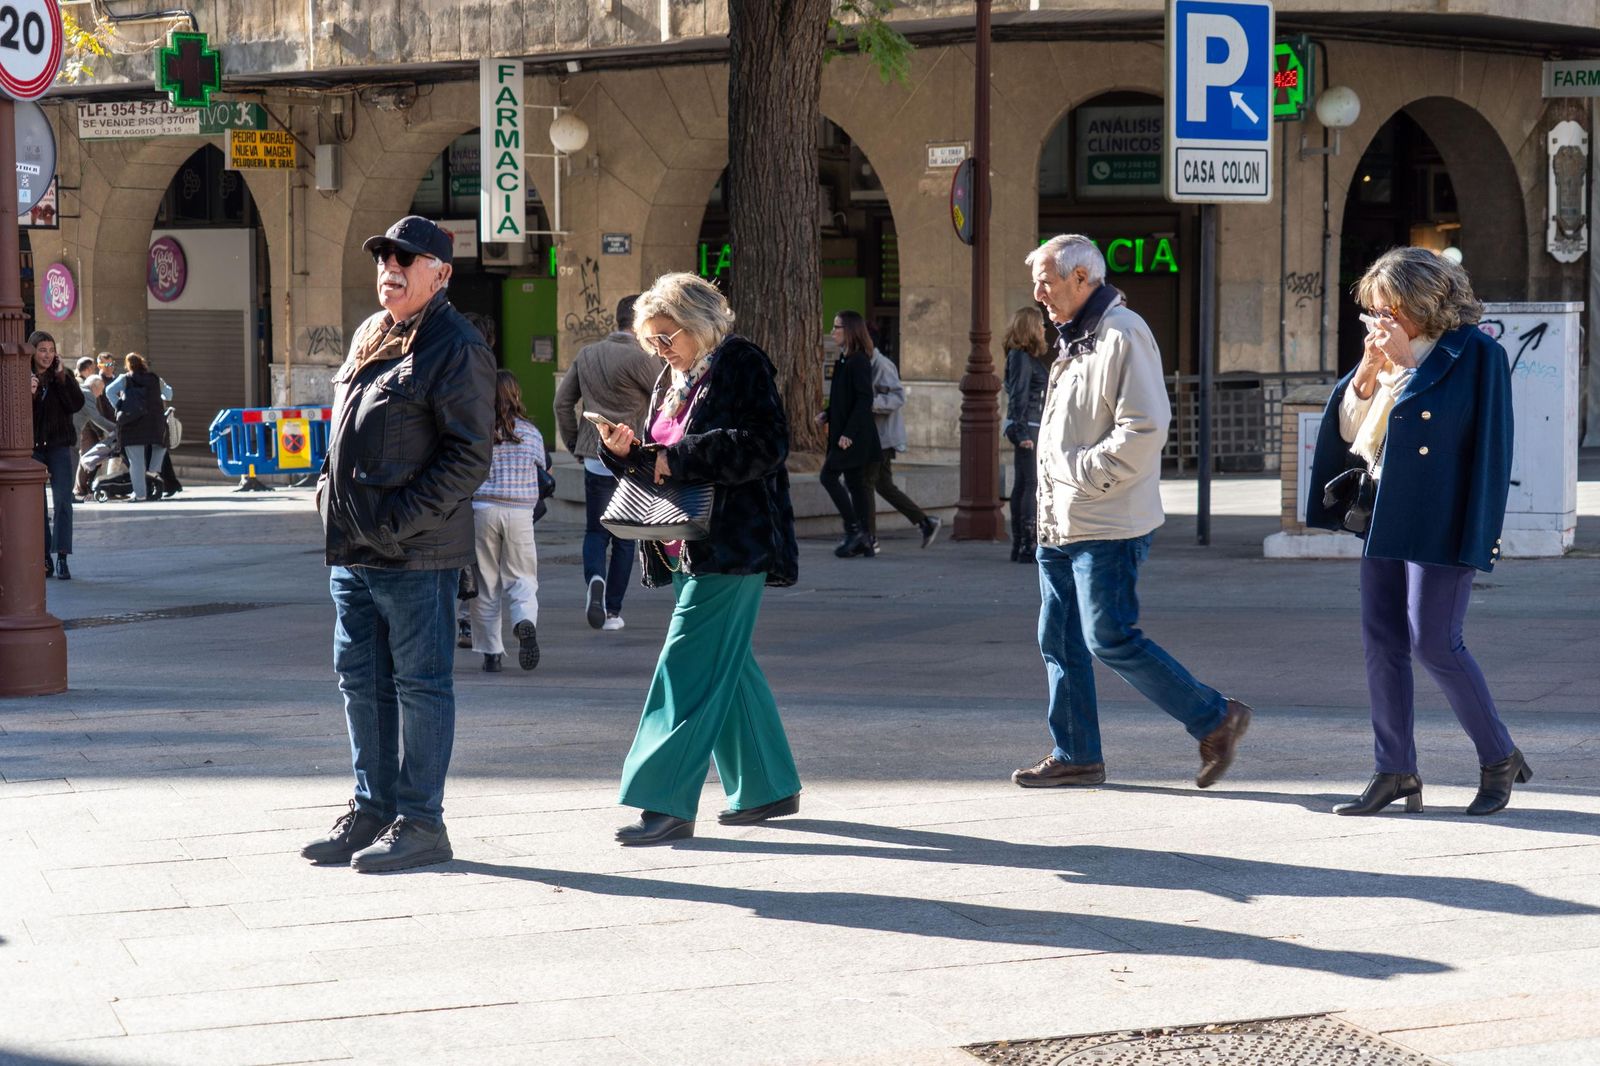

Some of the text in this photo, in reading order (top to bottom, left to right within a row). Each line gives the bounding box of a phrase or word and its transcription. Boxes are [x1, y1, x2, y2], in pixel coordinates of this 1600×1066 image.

[0, 5, 45, 55] 20
[1186, 12, 1249, 122] P
[78, 103, 107, 117] TLF:
[111, 102, 136, 116] 954
[83, 120, 97, 128] SE
[99, 119, 135, 127] VENDE
[138, 117, 164, 126] PISO
[1088, 116, 1161, 134] ANÁLISIS
[232, 131, 294, 145] PEDRO MORALES
[1088, 135, 1161, 152] CLÍNICOS
[235, 144, 292, 157] NUEVA IMAGEN
[495, 64, 520, 235] FARMACIA
[269, 158, 277, 168] DE
[1184, 160, 1260, 184] CASA COLON
[151, 244, 174, 265] Taco
[47, 268, 66, 288] Taco
